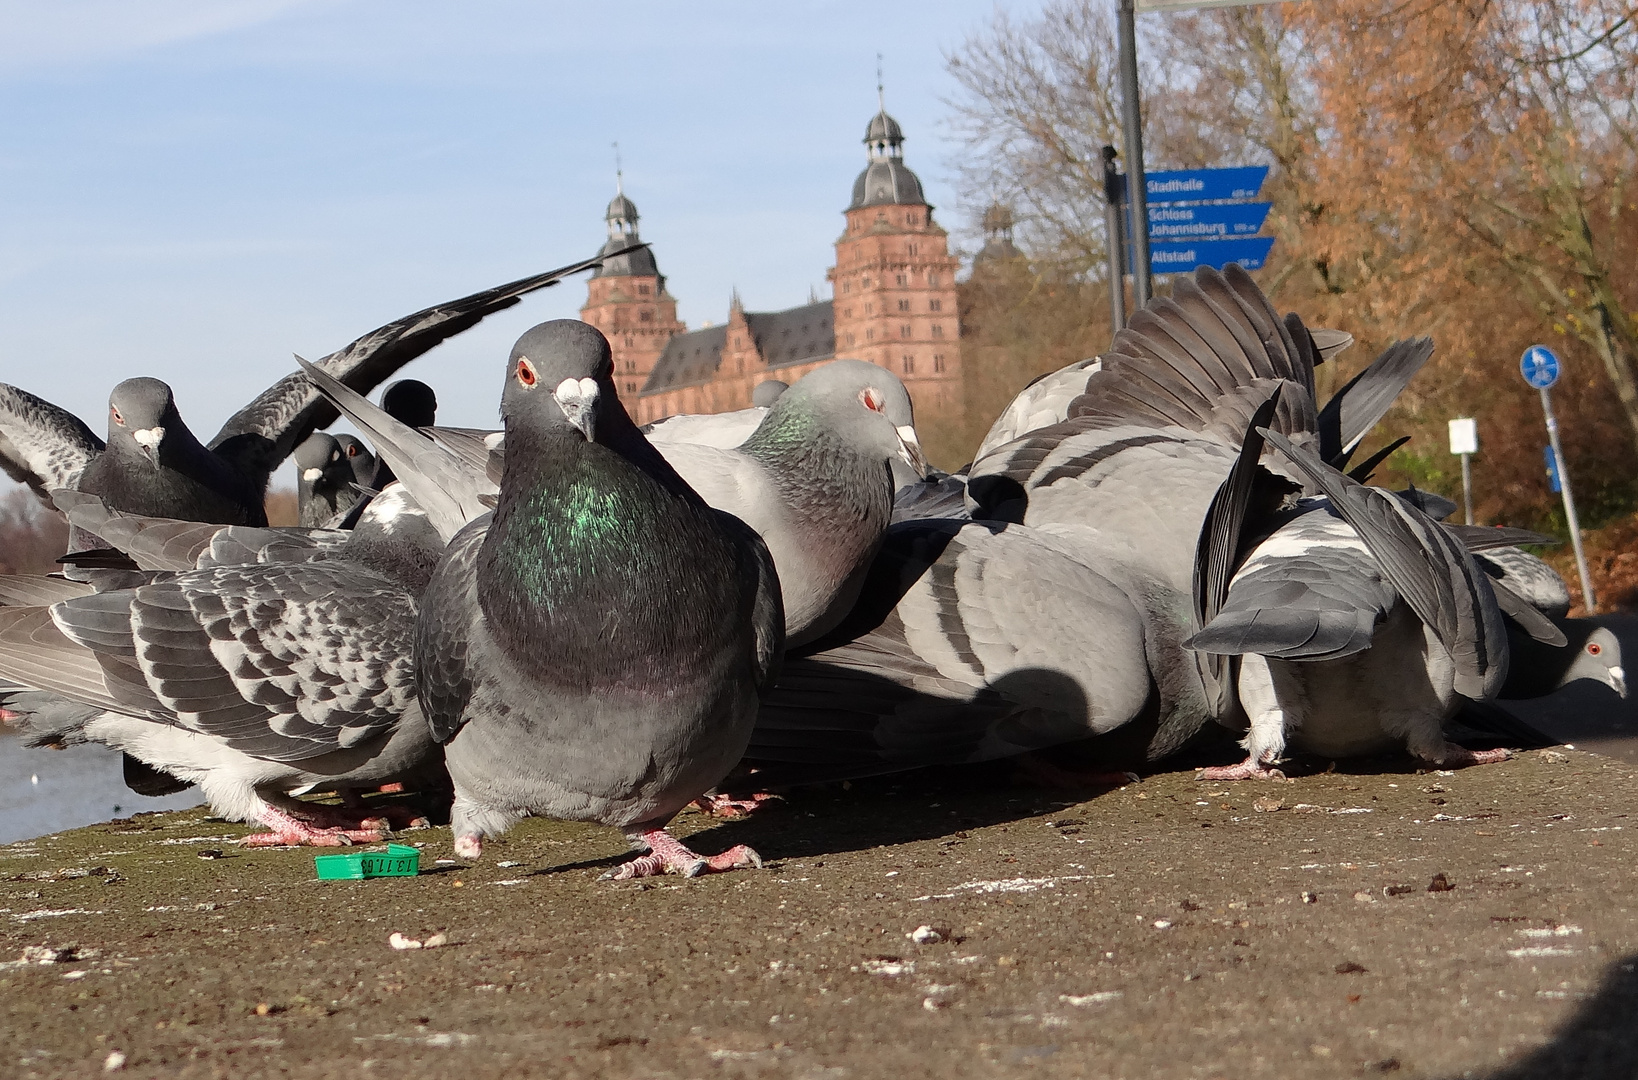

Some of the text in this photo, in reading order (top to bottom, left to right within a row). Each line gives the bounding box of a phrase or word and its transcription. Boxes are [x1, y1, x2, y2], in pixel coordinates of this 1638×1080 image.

[1147, 178, 1204, 193] Stadthalle
[1148, 208, 1194, 222] Schloss
[1150, 222, 1226, 236] Johannisburg
[1151, 249, 1197, 263] Altstadt
